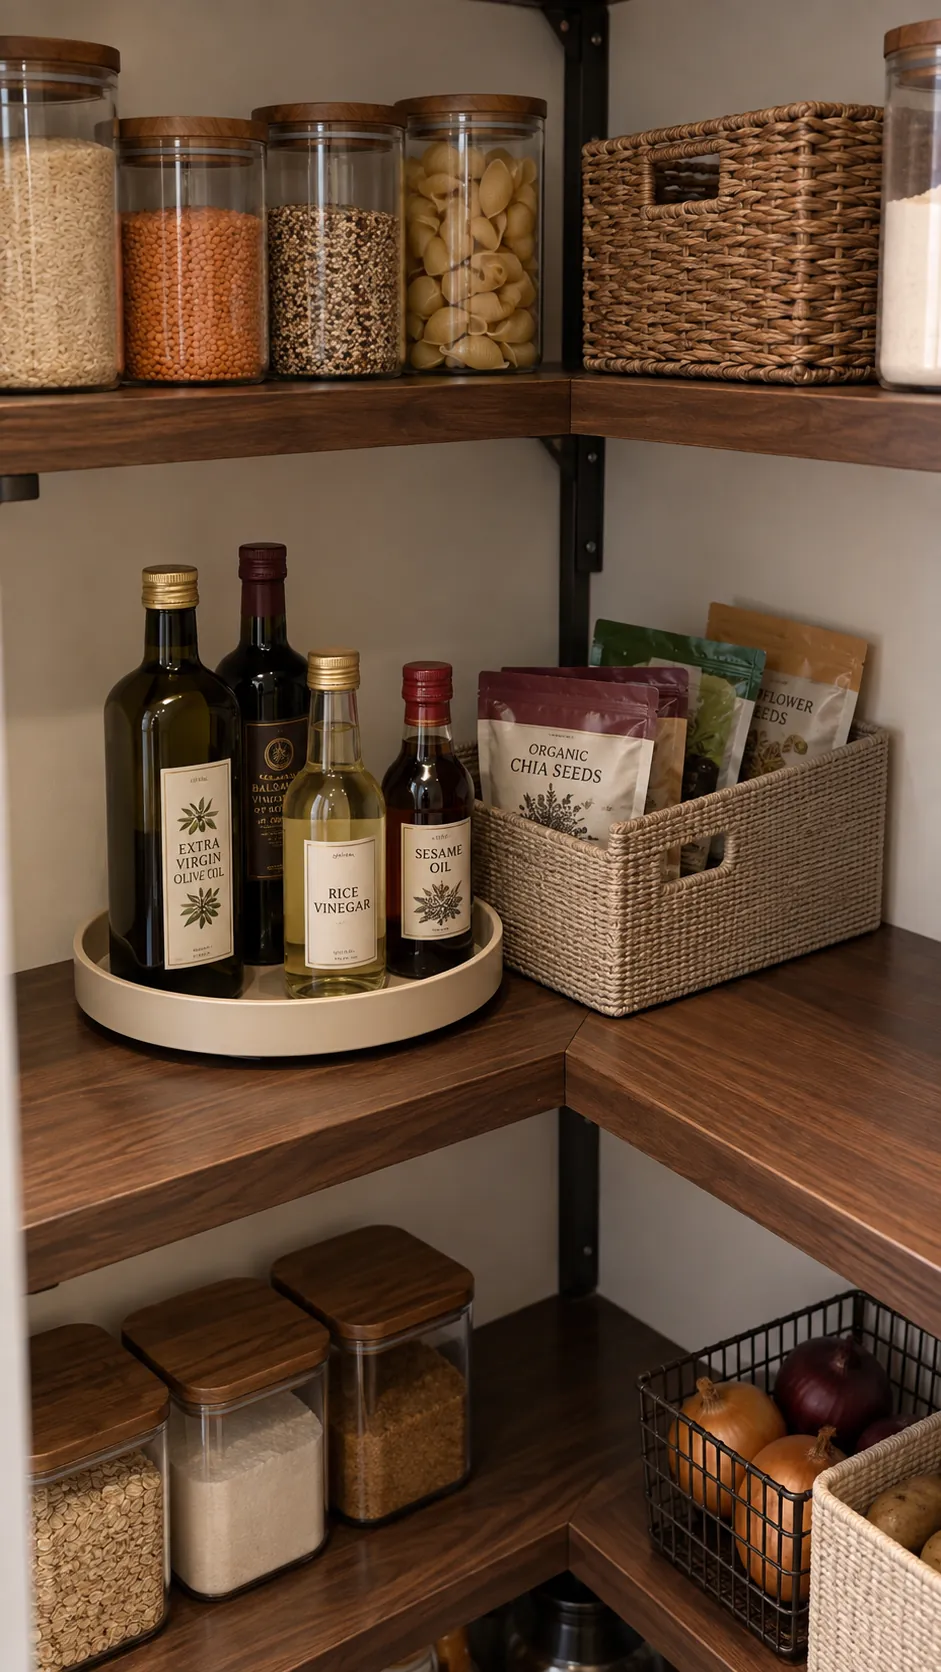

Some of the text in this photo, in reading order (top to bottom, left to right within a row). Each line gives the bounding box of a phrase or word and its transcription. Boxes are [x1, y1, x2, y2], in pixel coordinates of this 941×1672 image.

[753, 705, 788, 725] EEDS
[528, 743, 589, 762] ORGANIC
[510, 757, 602, 783] CHIA SEEDS
[179, 837, 220, 855] EXTRA
[415, 844, 463, 860] SESAME
[176, 851, 221, 870] VIRGIN
[429, 861, 452, 874] OIL
[173, 869, 205, 884] OLIVE
[328, 886, 359, 899] RICE
[313, 898, 371, 914] VINEGAR
